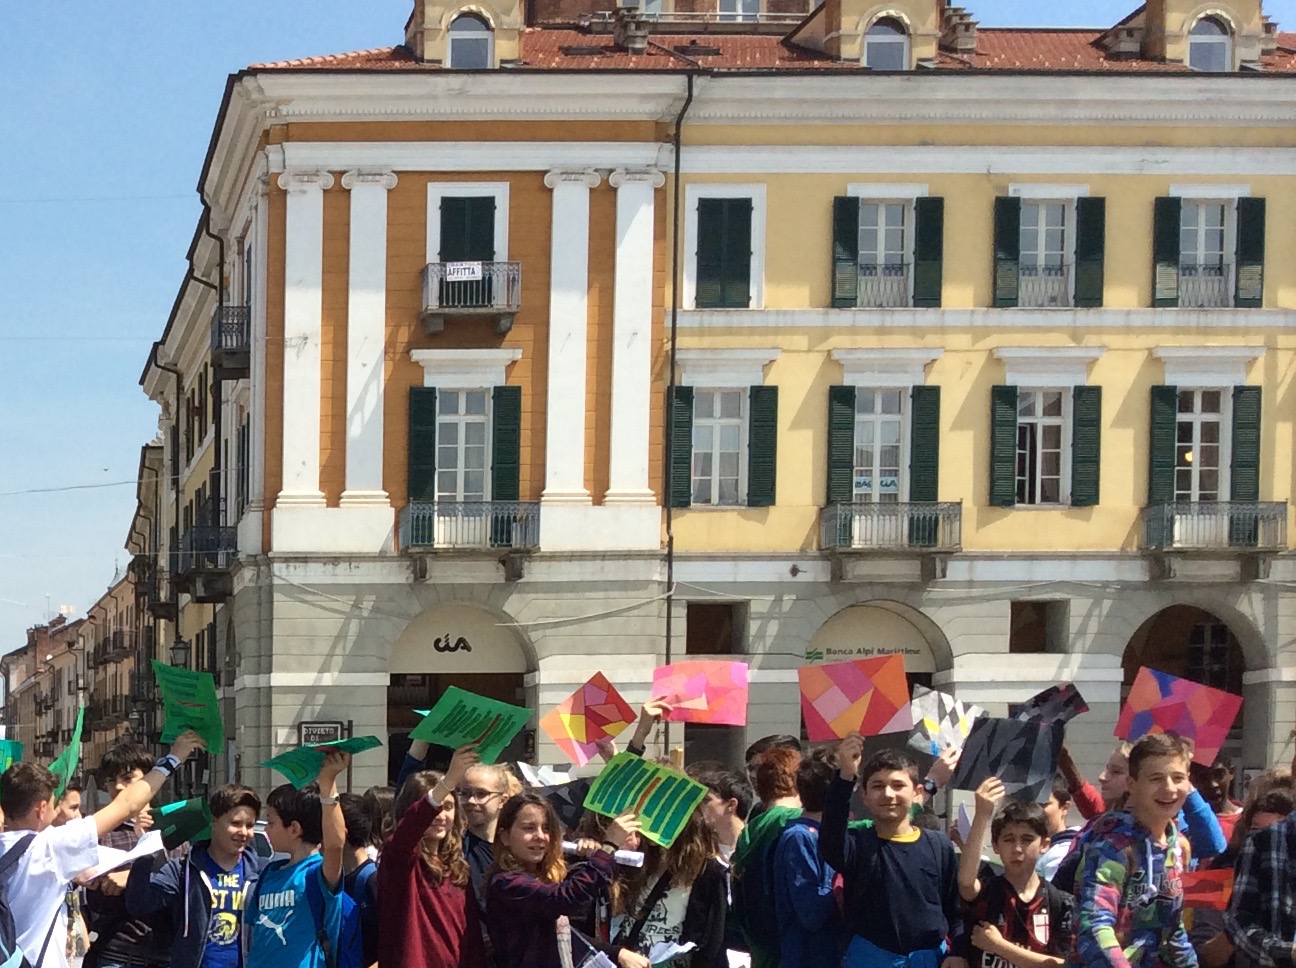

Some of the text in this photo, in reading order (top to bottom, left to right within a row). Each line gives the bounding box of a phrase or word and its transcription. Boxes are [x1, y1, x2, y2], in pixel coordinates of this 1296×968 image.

[448, 267, 476, 276] AFFITTA
[856, 647, 874, 656] Alpi
[217, 873, 239, 888] THE
[211, 889, 229, 910] ST
